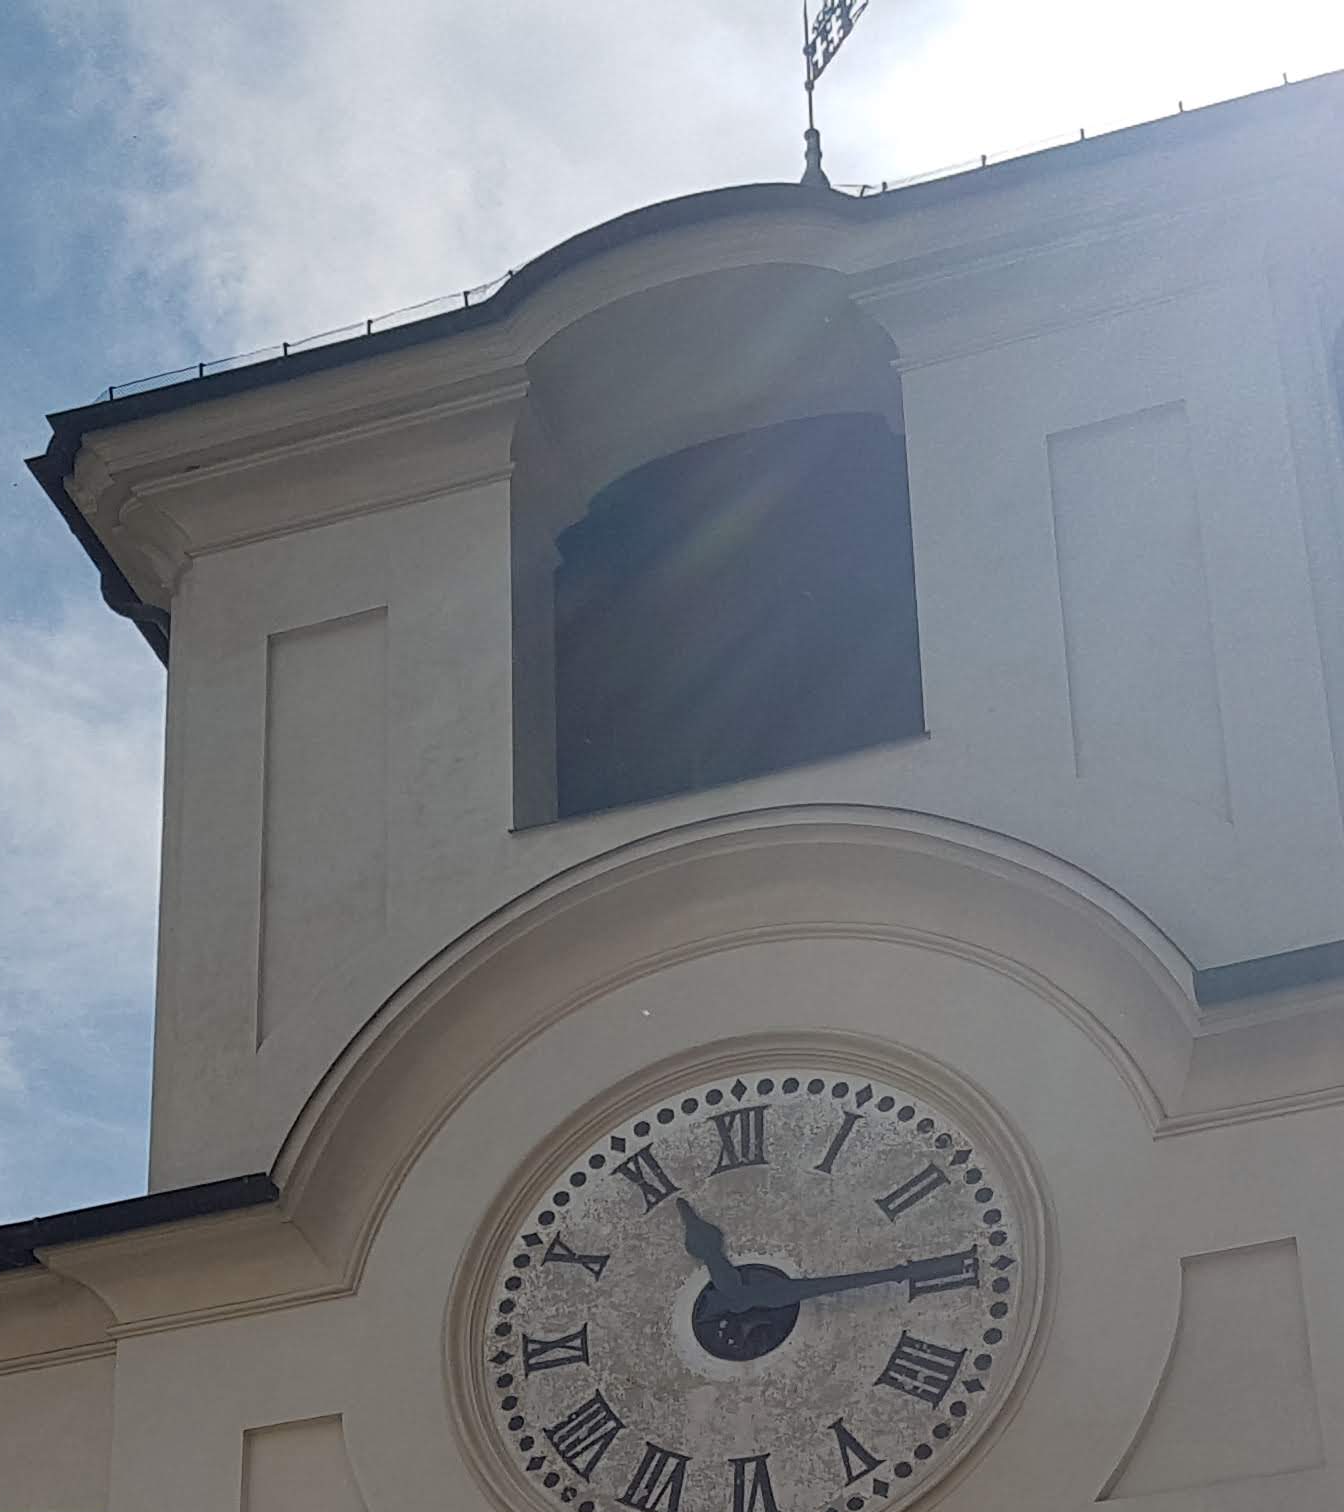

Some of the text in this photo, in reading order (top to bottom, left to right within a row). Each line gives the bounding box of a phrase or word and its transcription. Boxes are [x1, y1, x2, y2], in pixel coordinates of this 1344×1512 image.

[709, 1103, 773, 1177] XII
[813, 1110, 865, 1174] I
[611, 1142, 682, 1215] XI
[874, 1163, 952, 1223] II
[541, 1231, 611, 1282] X
[521, 1322, 590, 1378] IX
[827, 1416, 888, 1487] V
